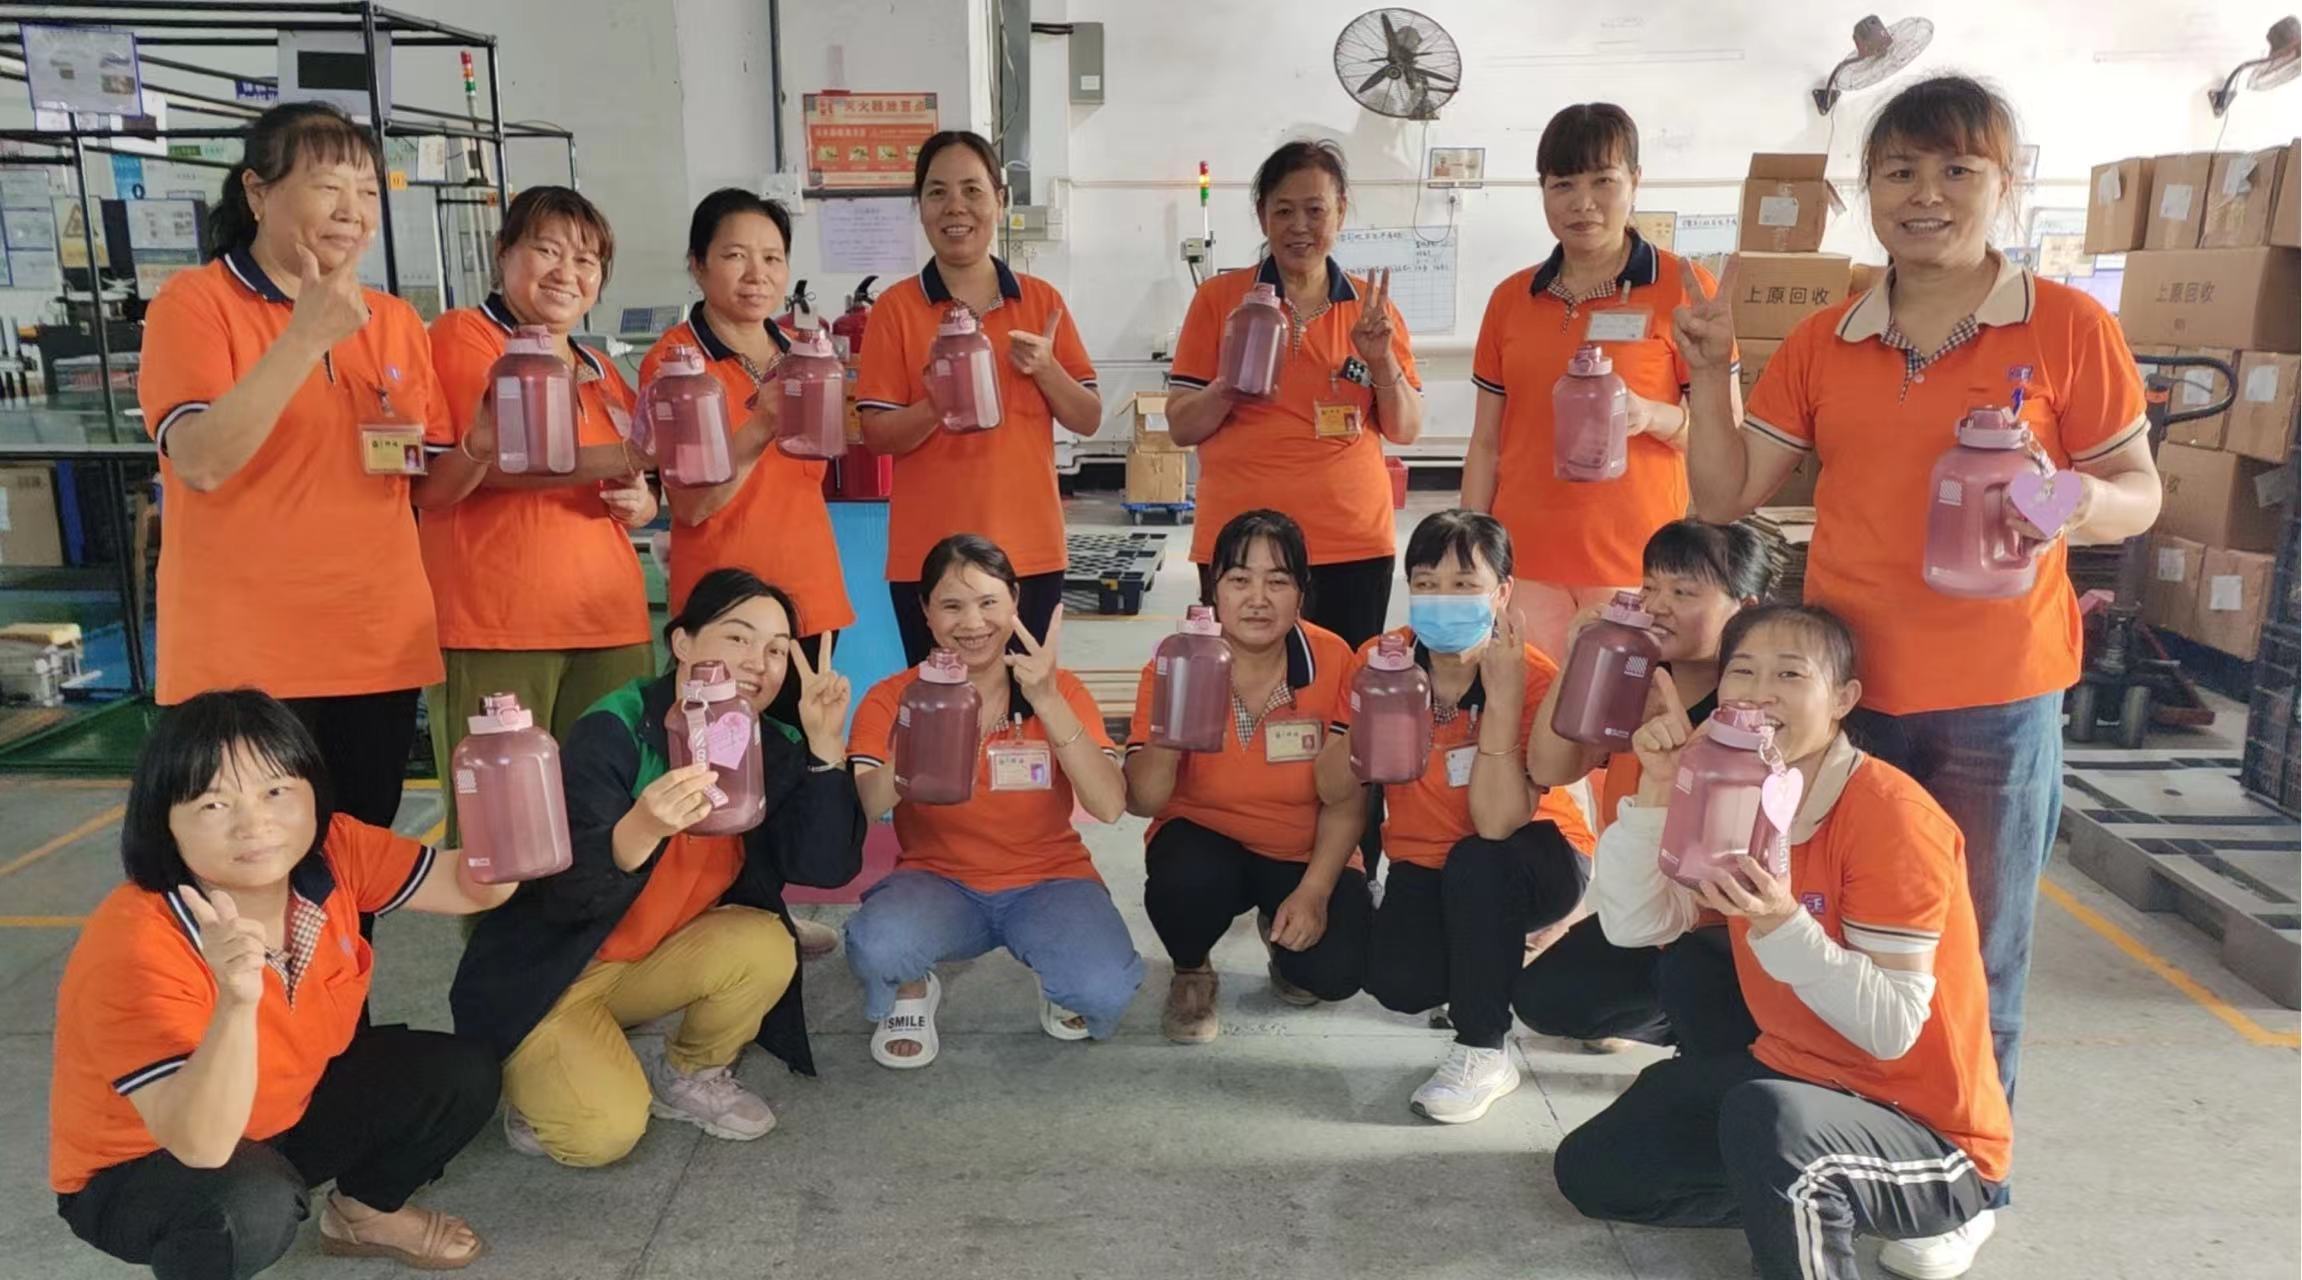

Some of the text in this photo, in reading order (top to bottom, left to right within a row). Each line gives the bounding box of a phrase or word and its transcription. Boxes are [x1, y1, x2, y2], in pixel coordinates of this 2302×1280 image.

[1743, 285, 1830, 305] 上原回收
[2156, 280, 2216, 303] 上原回收
[888, 1015, 926, 1029] SMILE
